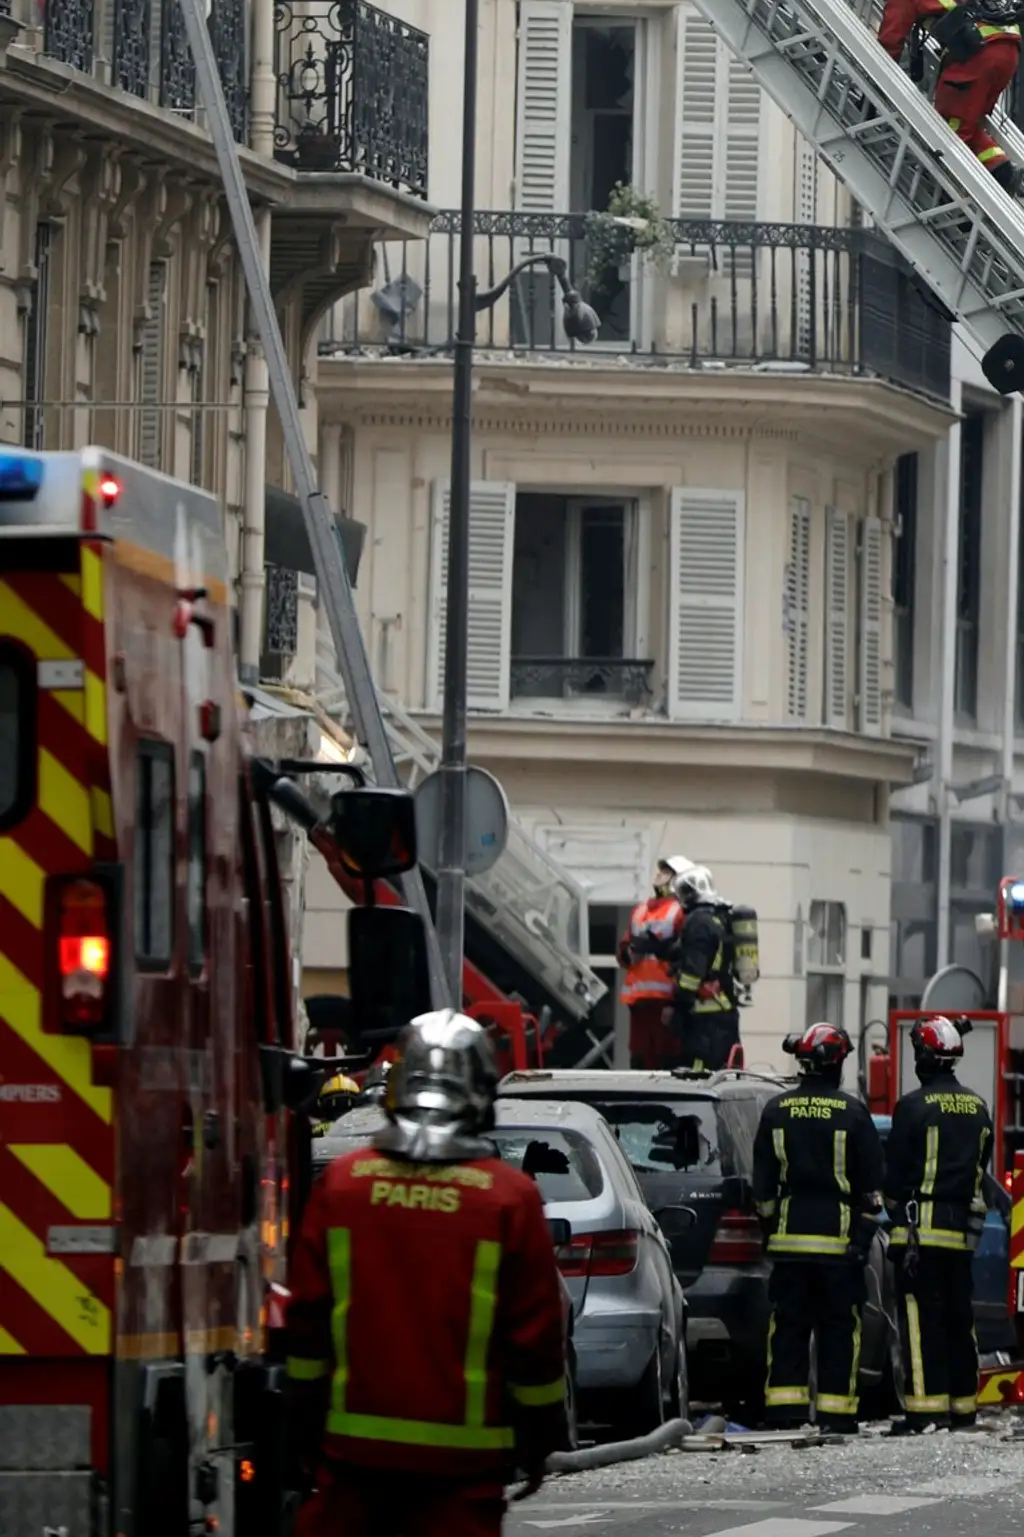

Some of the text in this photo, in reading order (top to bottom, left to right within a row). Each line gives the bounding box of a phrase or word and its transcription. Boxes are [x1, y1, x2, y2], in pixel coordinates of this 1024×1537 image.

[790, 1106, 832, 1119] PARIS
[941, 1102, 978, 1115] PARIS
[370, 1180, 461, 1213] PARIS
